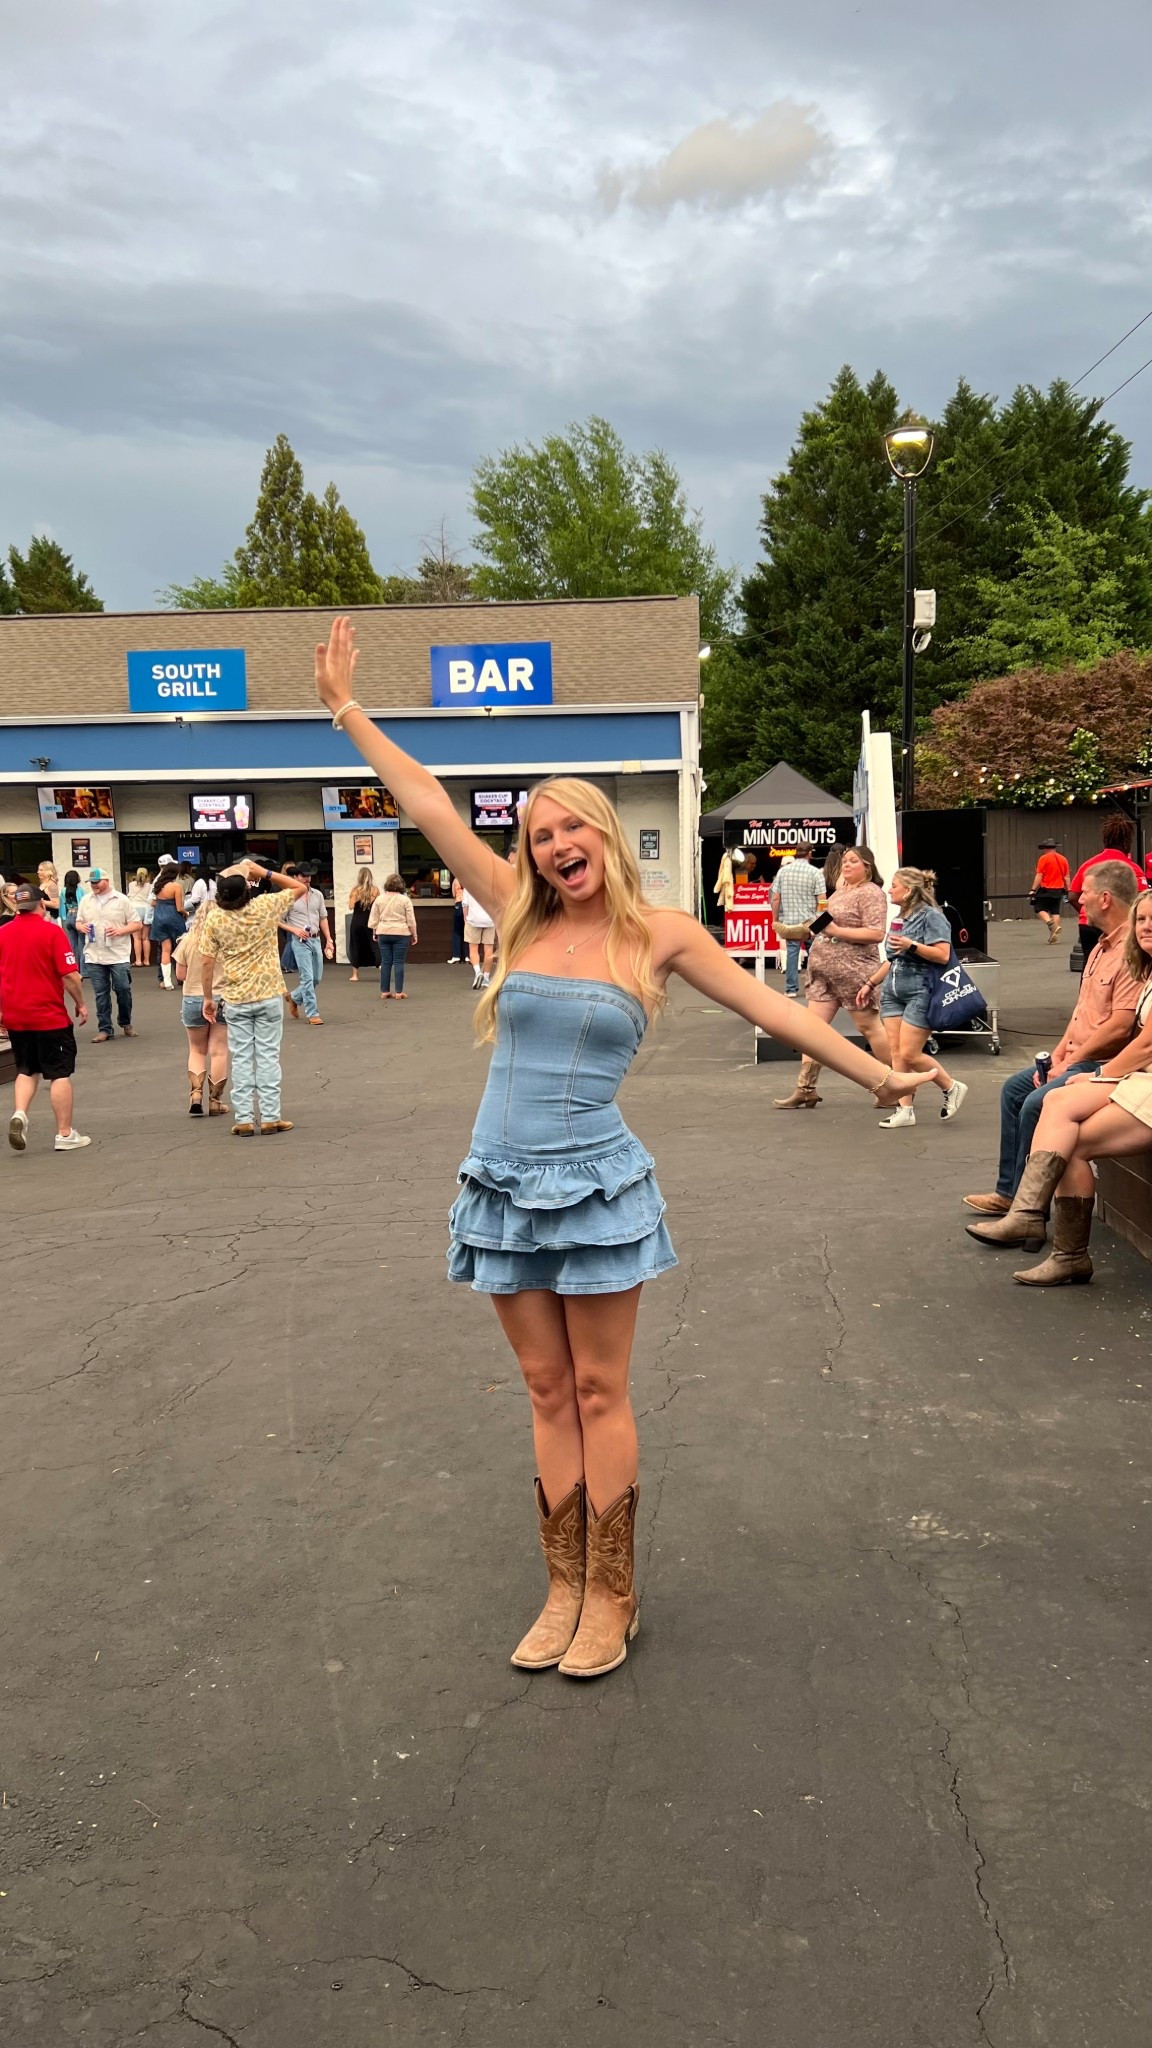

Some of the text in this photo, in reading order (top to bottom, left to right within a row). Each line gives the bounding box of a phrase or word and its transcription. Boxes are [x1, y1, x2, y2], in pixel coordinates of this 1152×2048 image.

[151, 663, 221, 680] SOUTH
[449, 658, 535, 694] BAR
[157, 681, 218, 698] GRILL
[743, 827, 837, 845] MINI DONUTS
[182, 850, 195, 859] citi
[726, 919, 769, 943] Mini
[941, 984, 977, 1007] JOHNSON
[944, 987, 960, 999] CODY
